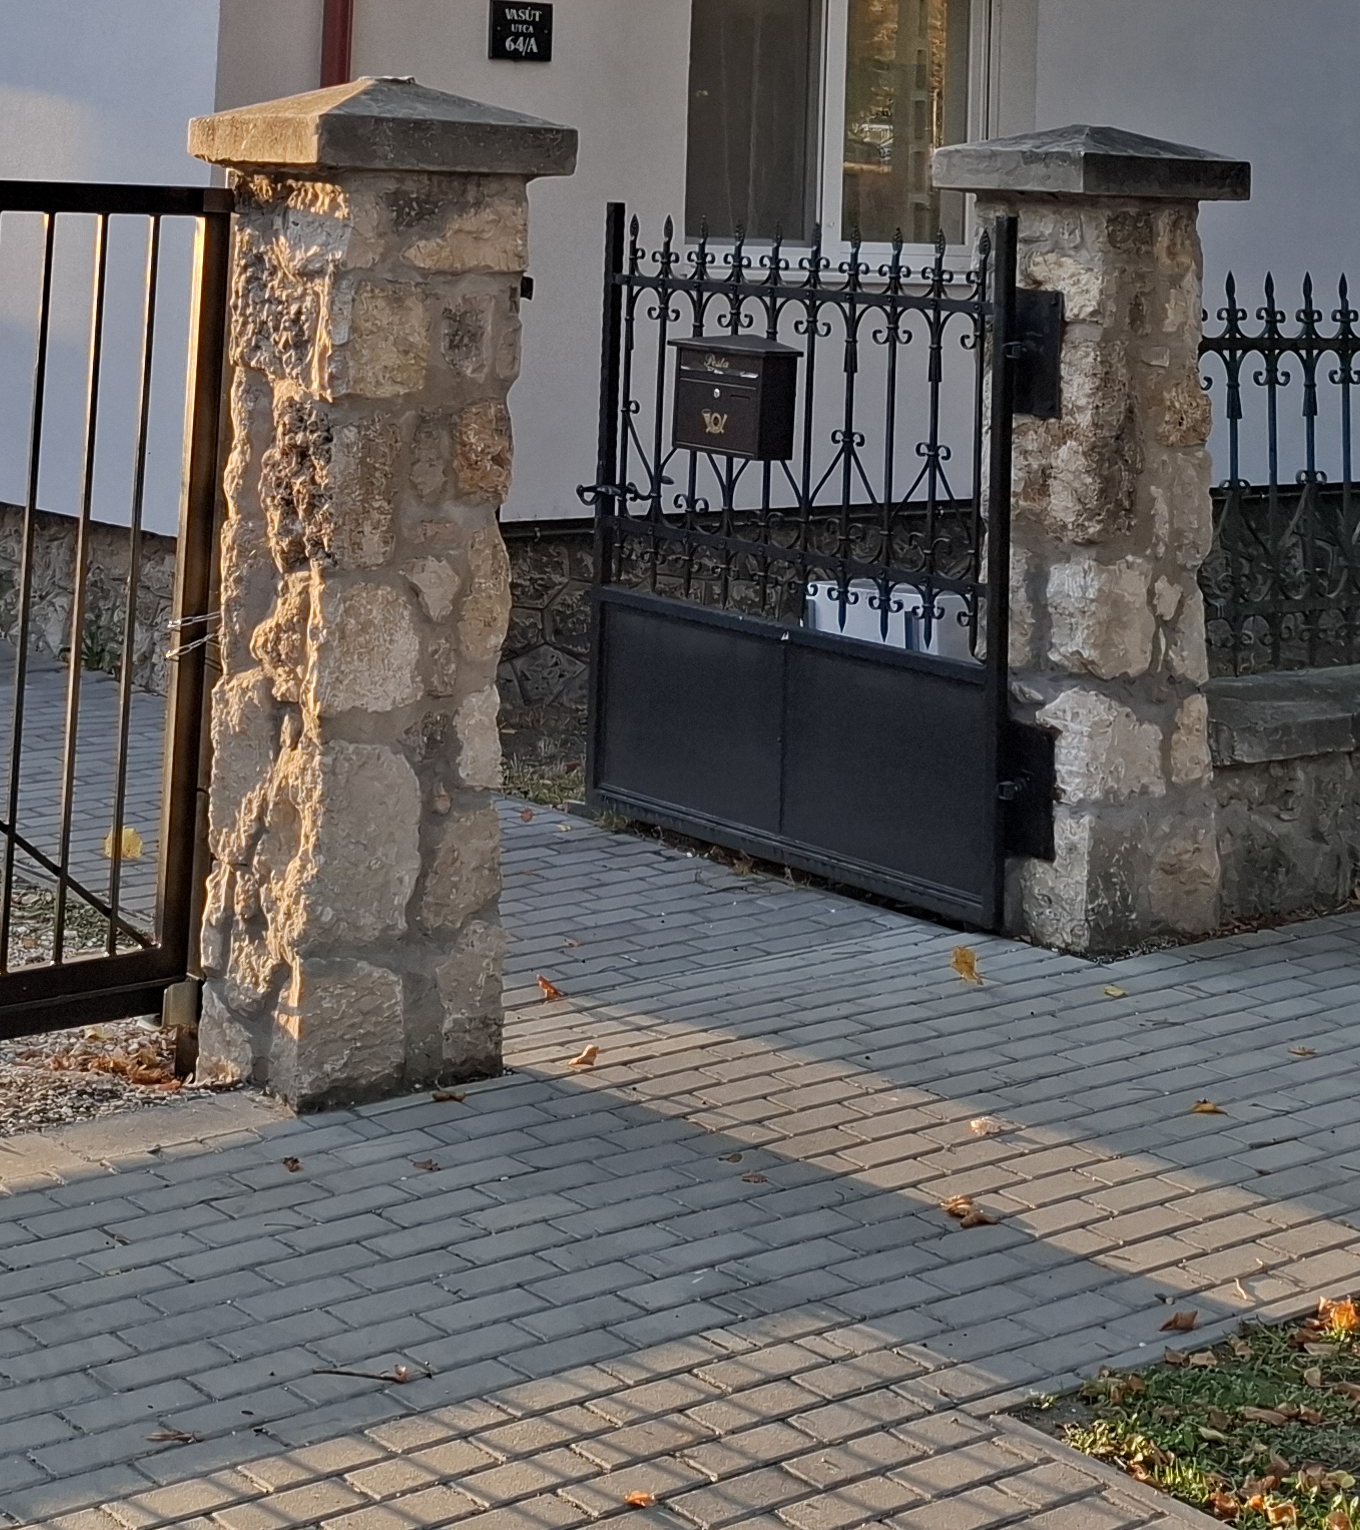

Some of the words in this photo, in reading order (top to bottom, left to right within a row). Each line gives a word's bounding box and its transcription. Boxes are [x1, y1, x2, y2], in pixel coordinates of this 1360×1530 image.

[505, 6, 542, 21] VASÚT
[511, 23, 534, 34] UTCA
[505, 35, 539, 56] 64/A
